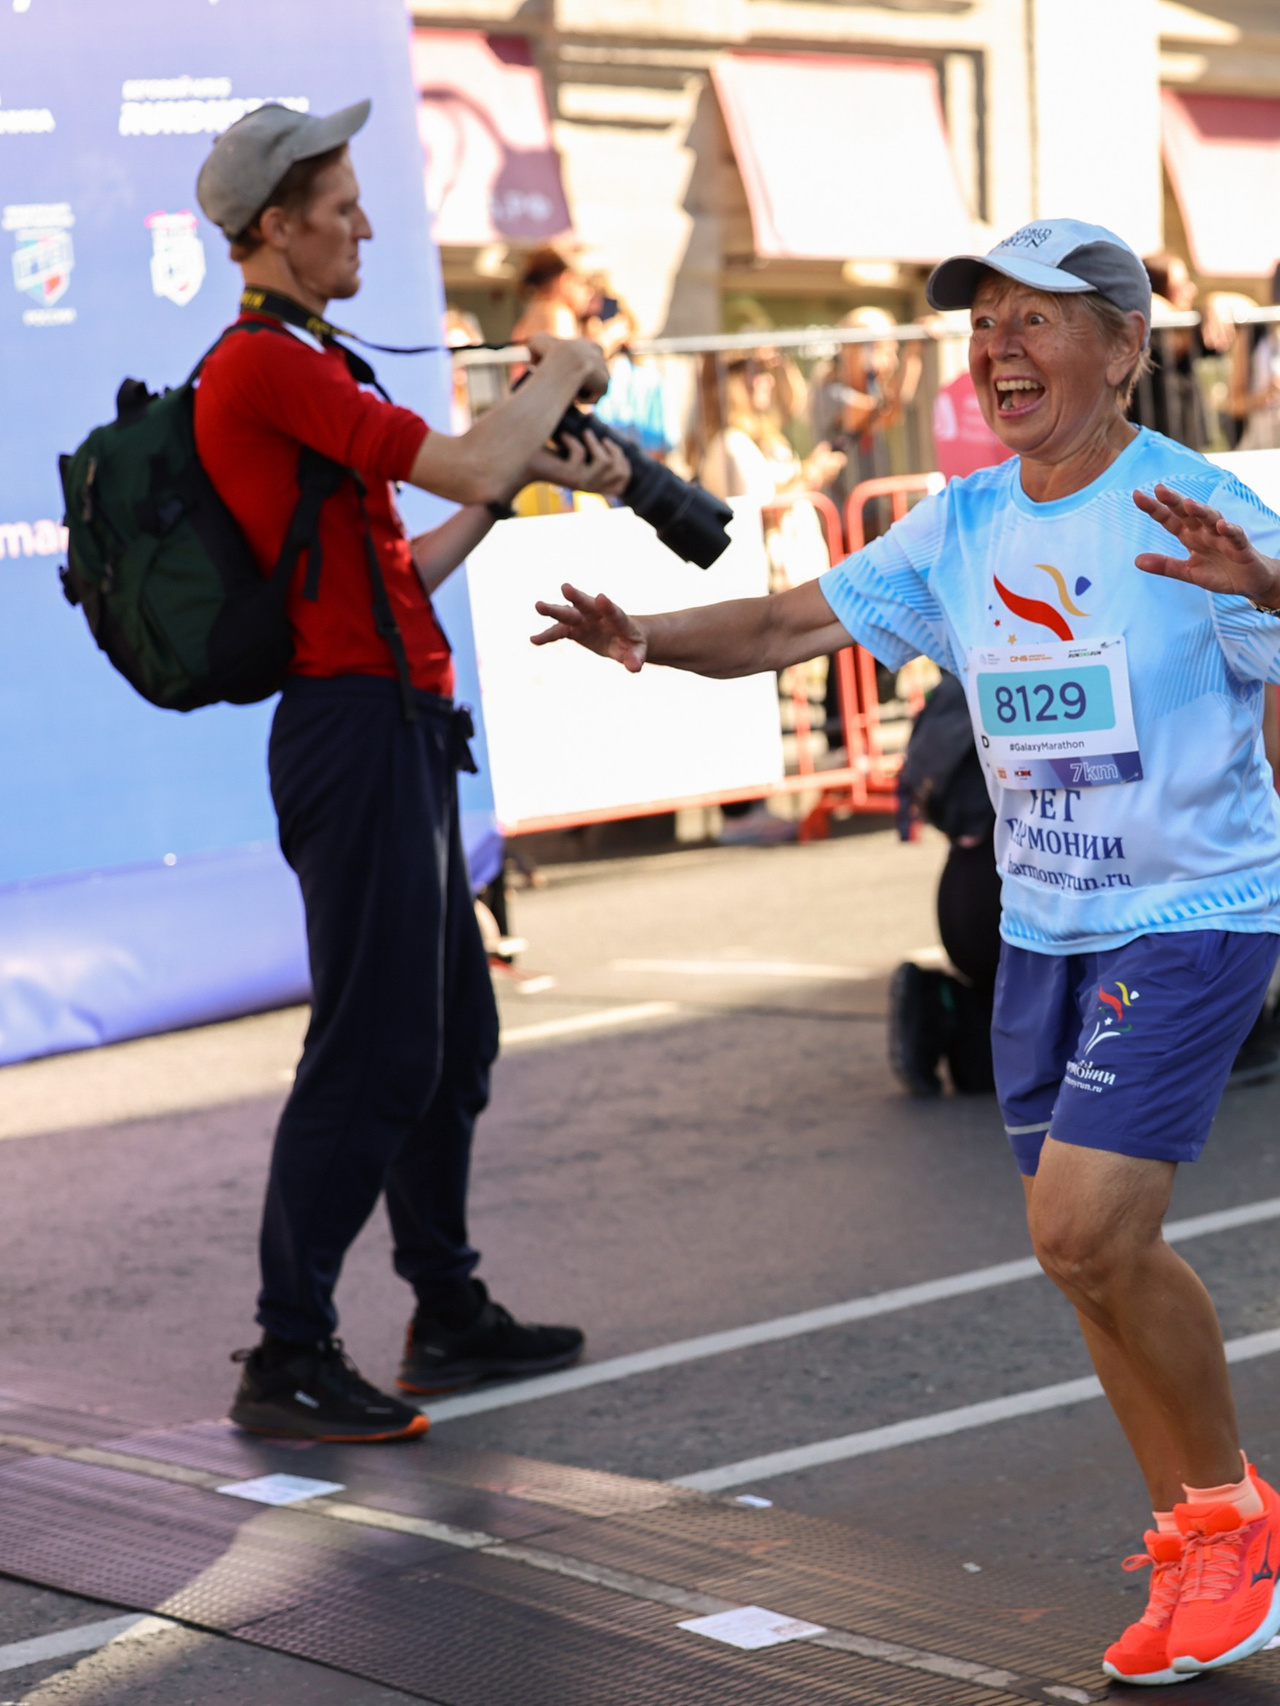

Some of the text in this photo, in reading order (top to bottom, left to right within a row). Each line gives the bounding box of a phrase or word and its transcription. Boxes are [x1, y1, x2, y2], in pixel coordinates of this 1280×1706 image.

[994, 681, 1087, 724] 8129
[1009, 738, 1085, 753] #GalaxyMarathon
[1069, 761, 1119, 783] 7km
[1007, 852, 1133, 892] harmonyrun.ru
